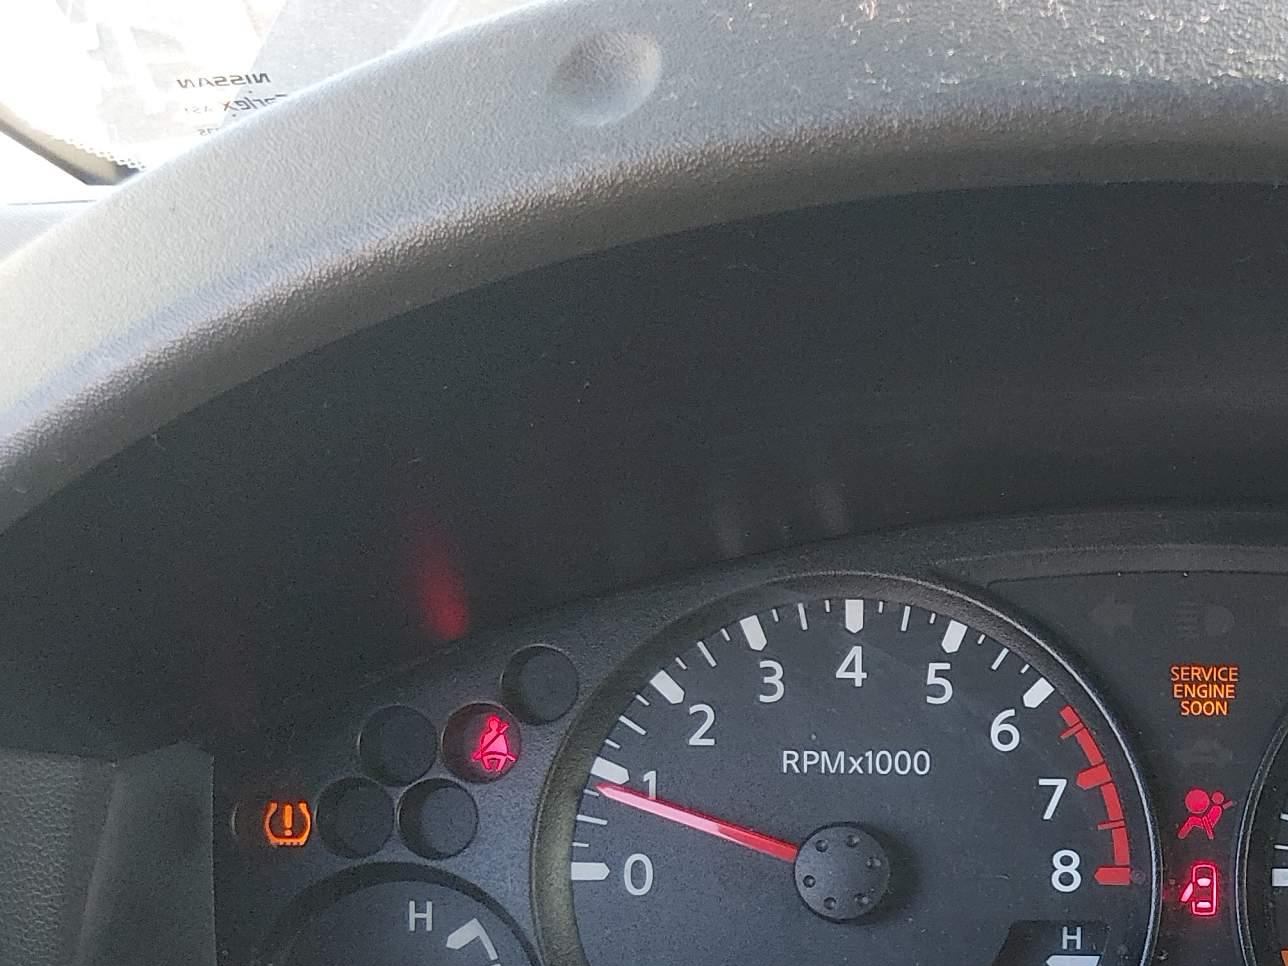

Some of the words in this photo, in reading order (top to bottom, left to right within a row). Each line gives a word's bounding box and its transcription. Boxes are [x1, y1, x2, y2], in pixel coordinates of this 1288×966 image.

[760, 660, 785, 703] 3
[836, 646, 867, 686] 4
[927, 662, 953, 704] 5
[1170, 666, 1238, 682] SERVICE
[1173, 684, 1235, 698] ENGINE
[1180, 700, 1228, 716] SOON
[689, 704, 715, 745] 2
[991, 709, 1020, 752] 6
[783, 751, 931, 775] RPMx1000
[643, 770, 657, 800] 1
[1038, 779, 1067, 820] 7
[623, 853, 654, 896] 0
[1051, 849, 1082, 893] 8
[409, 900, 433, 932] H
[1061, 927, 1082, 950] H
